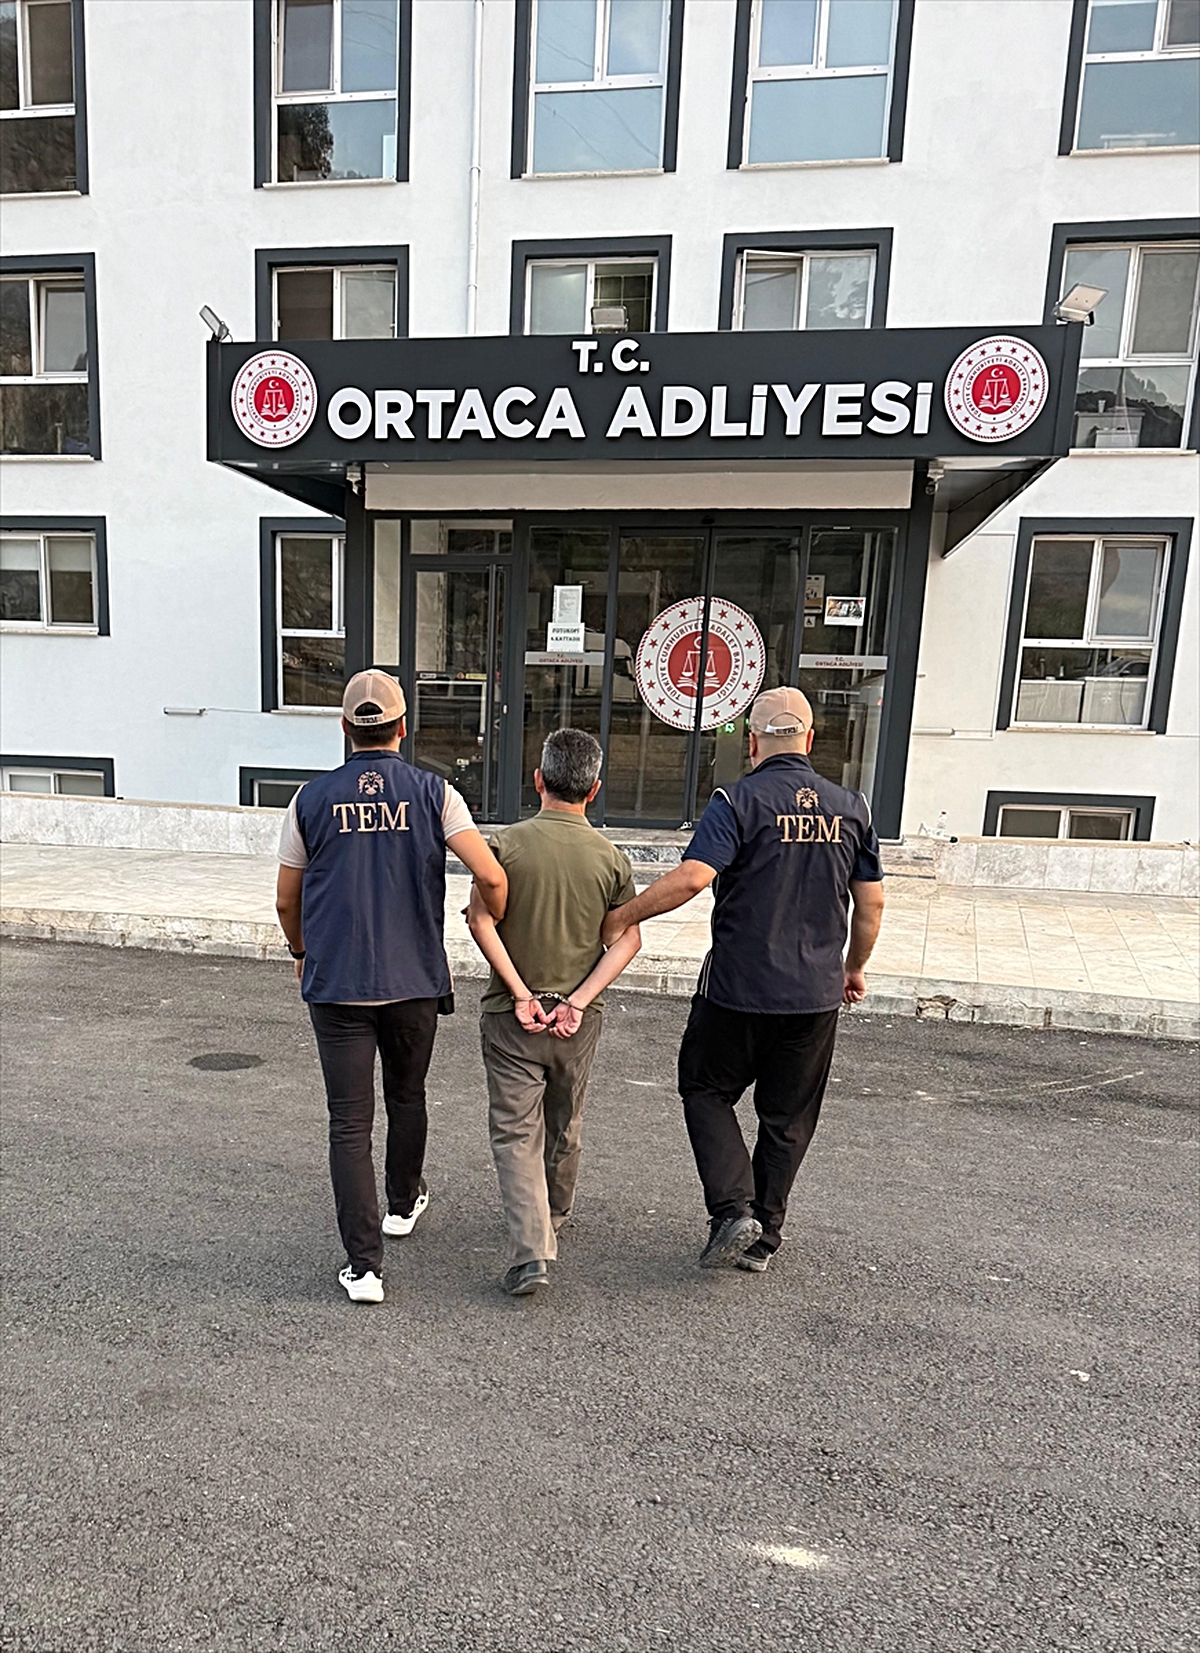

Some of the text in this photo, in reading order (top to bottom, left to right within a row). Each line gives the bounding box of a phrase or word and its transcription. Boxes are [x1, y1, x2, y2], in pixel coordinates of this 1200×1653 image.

[327, 386, 585, 440] ORTACA
[658, 622, 741, 700] TÜRKİYE CUMHURİYE ADALET BAKANLIĞI
[332, 801, 410, 834] TEM
[776, 814, 843, 843] TEM
